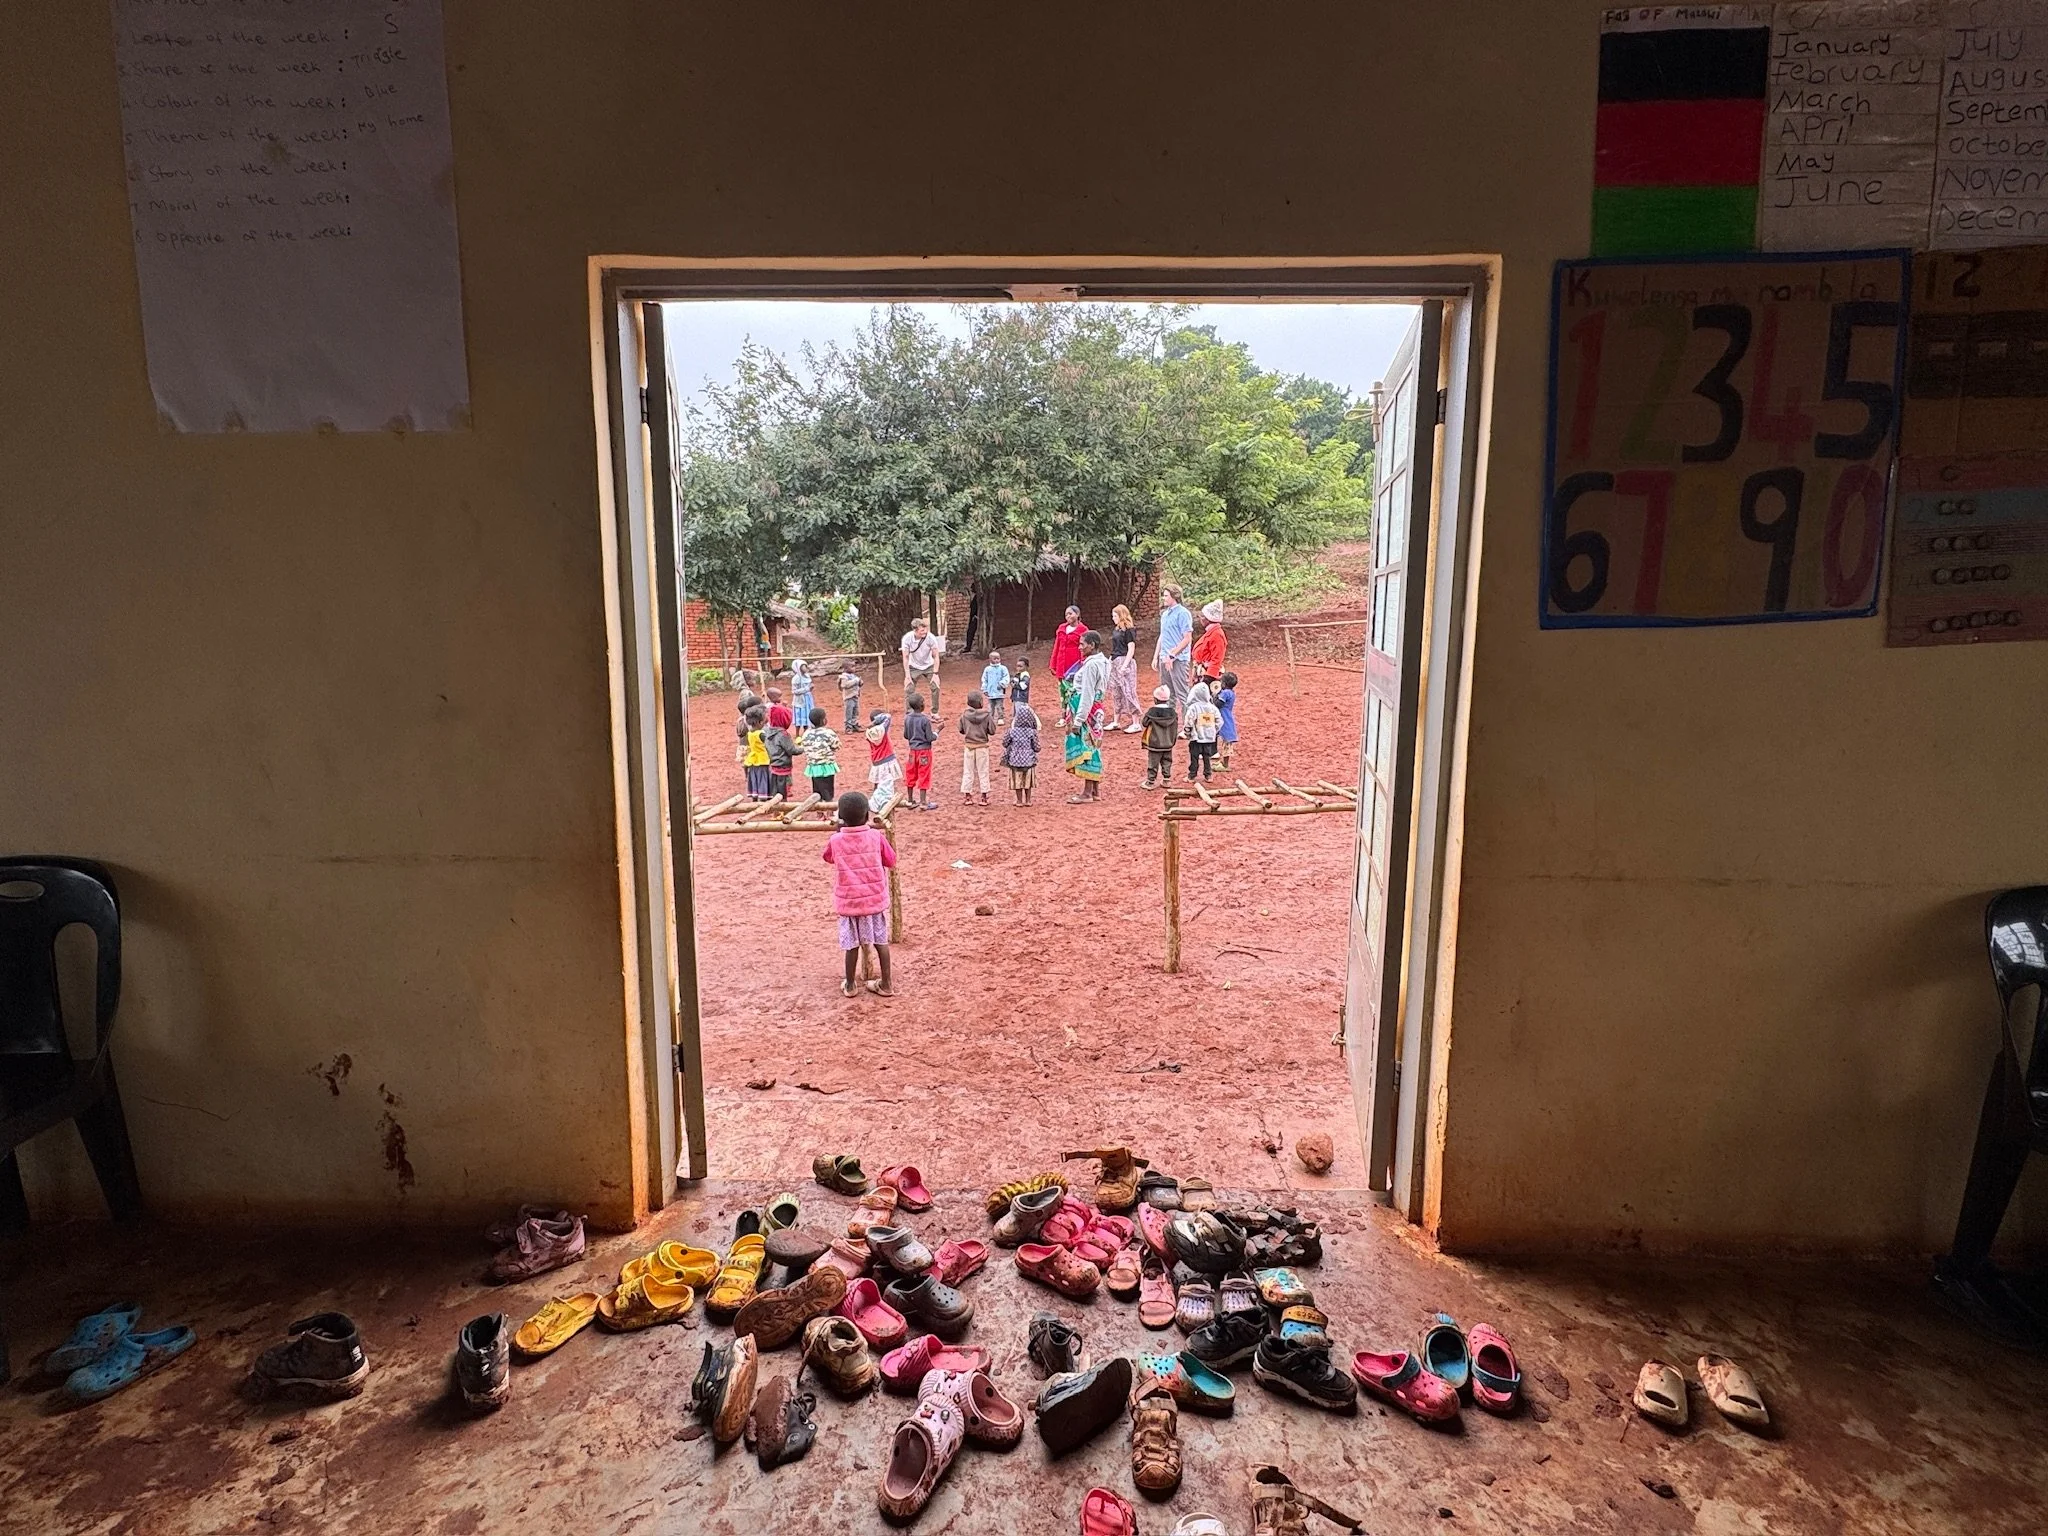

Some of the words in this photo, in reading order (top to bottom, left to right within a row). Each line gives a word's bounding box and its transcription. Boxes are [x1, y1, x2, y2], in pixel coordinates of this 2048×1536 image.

[206, 32, 222, 45] of
[233, 31, 267, 45] the
[385, 13, 399, 34] S
[1773, 32, 1890, 58] January
[1947, 28, 2024, 61] July
[229, 63, 258, 74] the
[1771, 60, 1925, 85] February
[1949, 68, 2048, 96] Augus
[142, 93, 199, 110] Colour
[245, 92, 276, 109] the
[1773, 90, 1871, 113] March
[142, 127, 212, 144] Theme
[220, 127, 235, 141] of
[247, 126, 279, 142] the
[386, 113, 425, 128] home
[240, 161, 273, 177] the
[1776, 152, 1834, 175] May
[148, 199, 200, 214] Moral
[216, 195, 231, 210] of
[247, 193, 280, 207] the
[1775, 176, 1884, 207] June
[243, 231, 258, 243] of
[269, 232, 295, 242] the
[1952, 254, 1982, 298] 2
[1568, 310, 1606, 458] 1
[1620, 310, 1688, 458] 2
[1681, 303, 1753, 463] 3
[1748, 305, 1814, 462] 4
[1814, 301, 1900, 459] 5
[1551, 470, 1615, 612] 6
[1614, 470, 1676, 612] 7
[1740, 466, 1805, 611] 9
